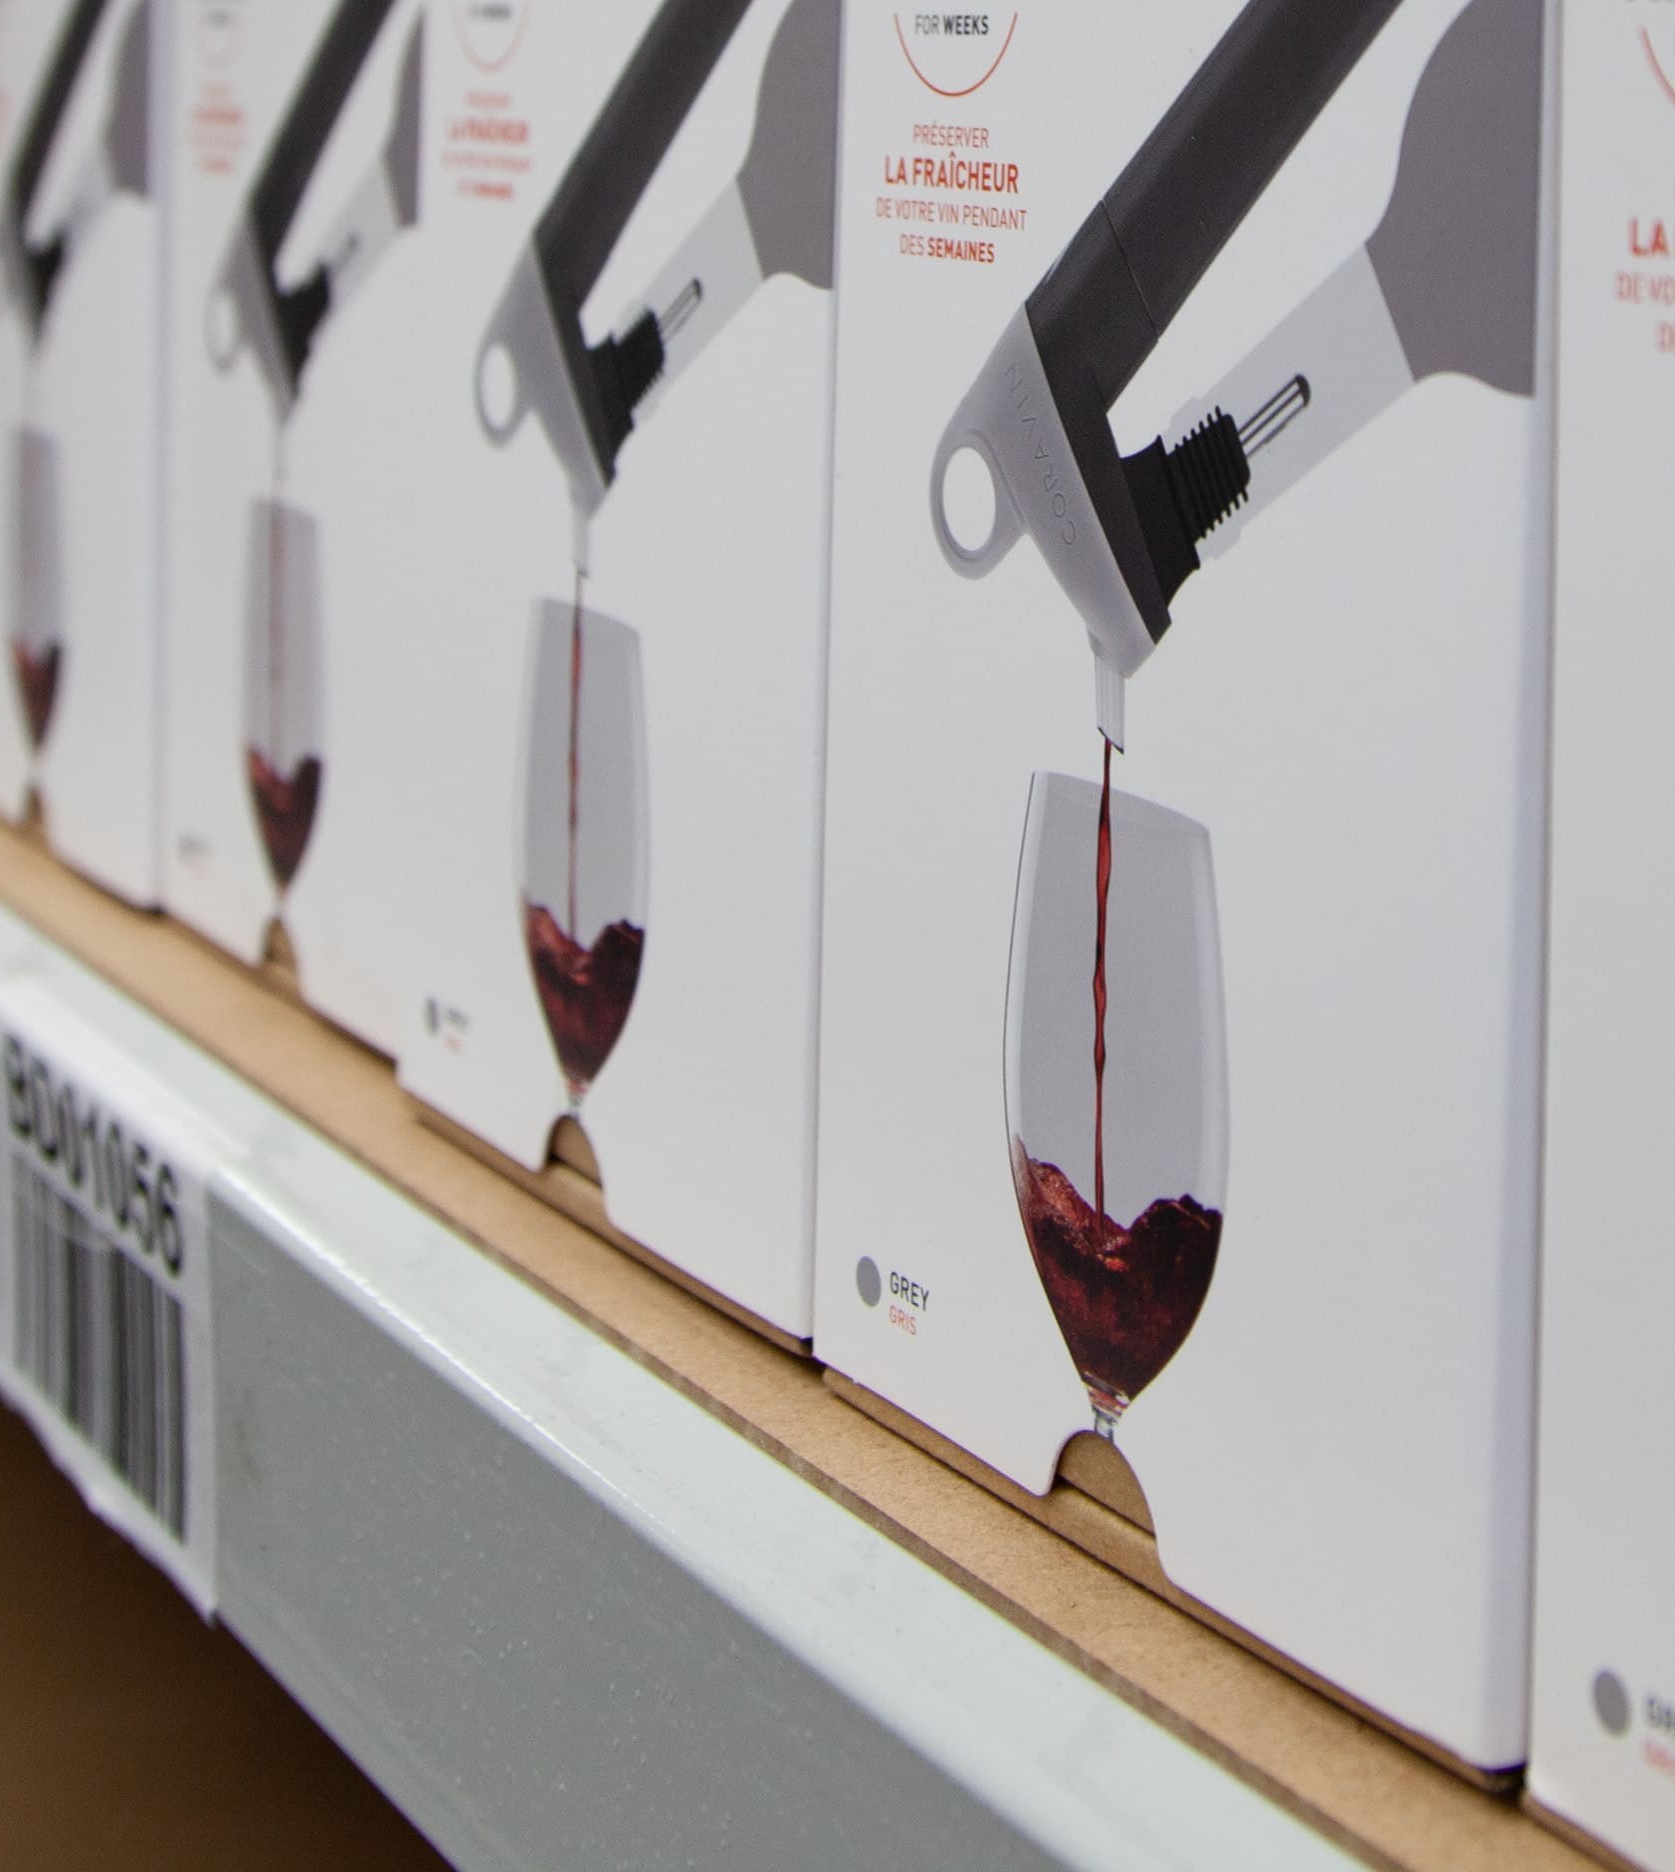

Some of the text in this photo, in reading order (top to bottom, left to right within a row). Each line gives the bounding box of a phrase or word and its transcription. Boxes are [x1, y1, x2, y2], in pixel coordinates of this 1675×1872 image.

[914, 14, 990, 36] FOR WEEKS
[912, 120, 990, 149] PRÉSERVER
[885, 150, 1019, 194] LA FRAÎCHEUR
[876, 197, 1027, 231] DE VOTRE VIN PENDANT
[899, 233, 995, 264] DES SEMAINES
[1629, 216, 1670, 257] LA
[5, 1033, 185, 1280] BD01056
[889, 1271, 930, 1312] GREY
[888, 1304, 917, 1336] GRIS
